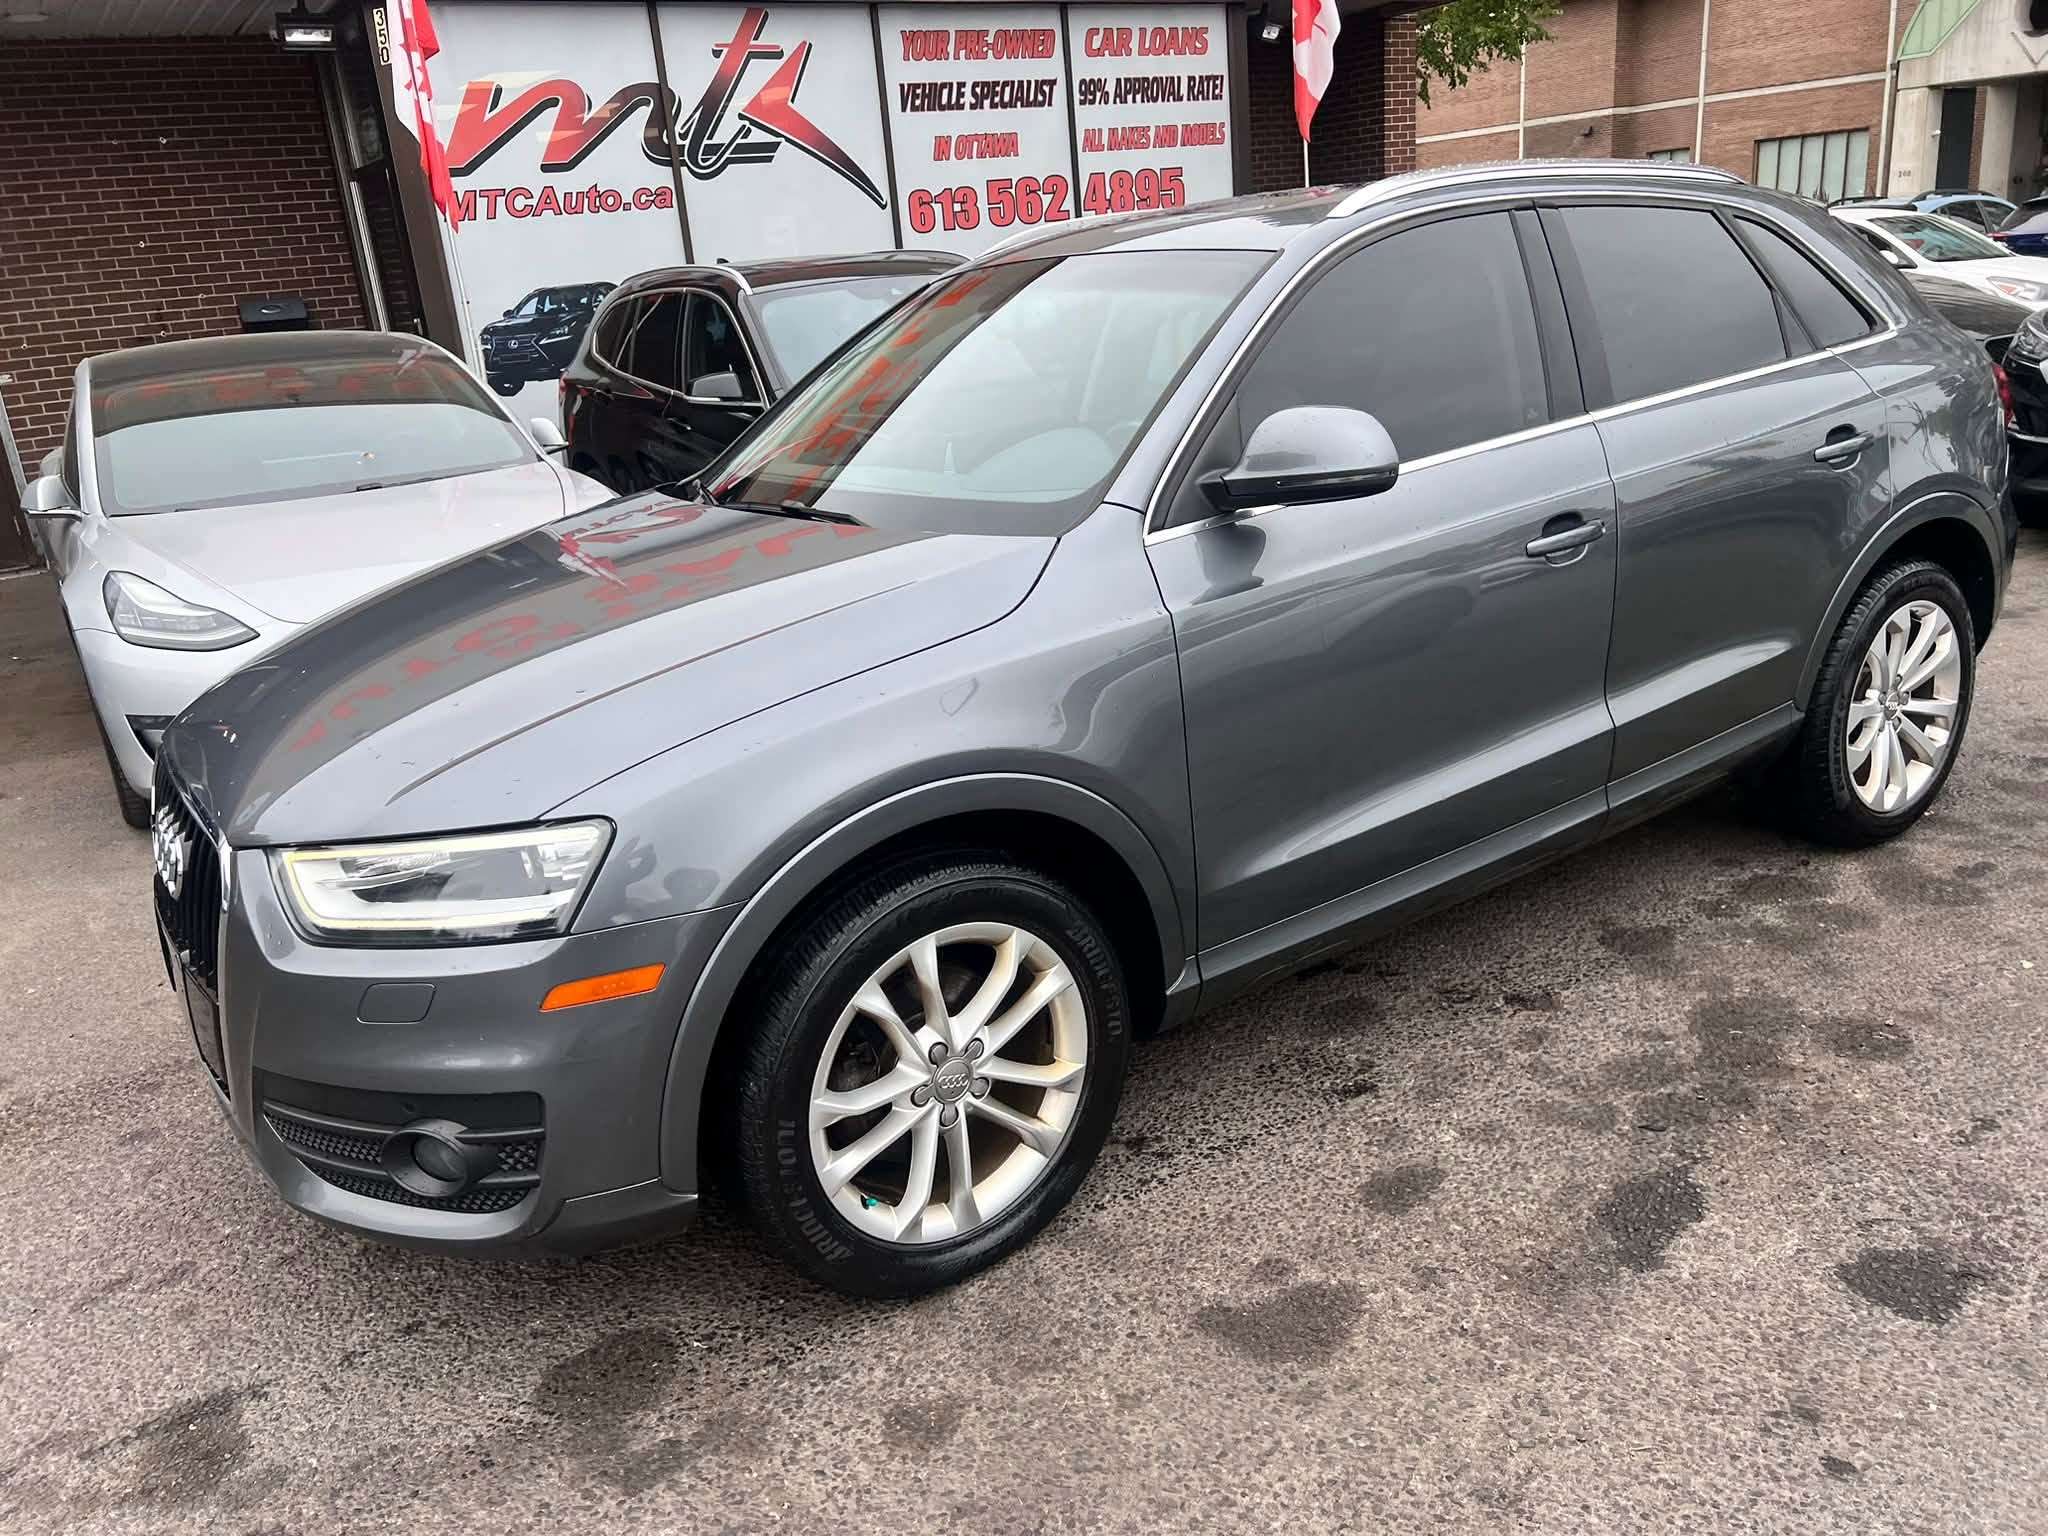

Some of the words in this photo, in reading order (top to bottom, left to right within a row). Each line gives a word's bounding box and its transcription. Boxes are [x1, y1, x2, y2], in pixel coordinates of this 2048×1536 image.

[375, 9, 390, 63] 350
[901, 29, 950, 61] YOUR
[953, 28, 1056, 61] PRE-OWNED
[1085, 27, 1133, 57] CAR
[1138, 26, 1209, 57] LOANS
[899, 82, 967, 113] VEHICLE
[969, 77, 1058, 111] SPECIALIST
[1078, 78, 1110, 106] 99%
[1113, 76, 1184, 104] APPROVAL
[1187, 74, 1224, 101] RATE!
[933, 135, 952, 161] IN
[954, 132, 1019, 160] OTTAWA
[1082, 128, 1105, 152] ALL
[1106, 125, 1150, 151] MAKES
[1152, 124, 1178, 148] AND
[1180, 121, 1226, 147] MODELS
[450, 183, 674, 222] MTCAuto.ca
[907, 185, 981, 234] 613
[985, 174, 1071, 227] 562
[1083, 166, 1186, 215] 4895
